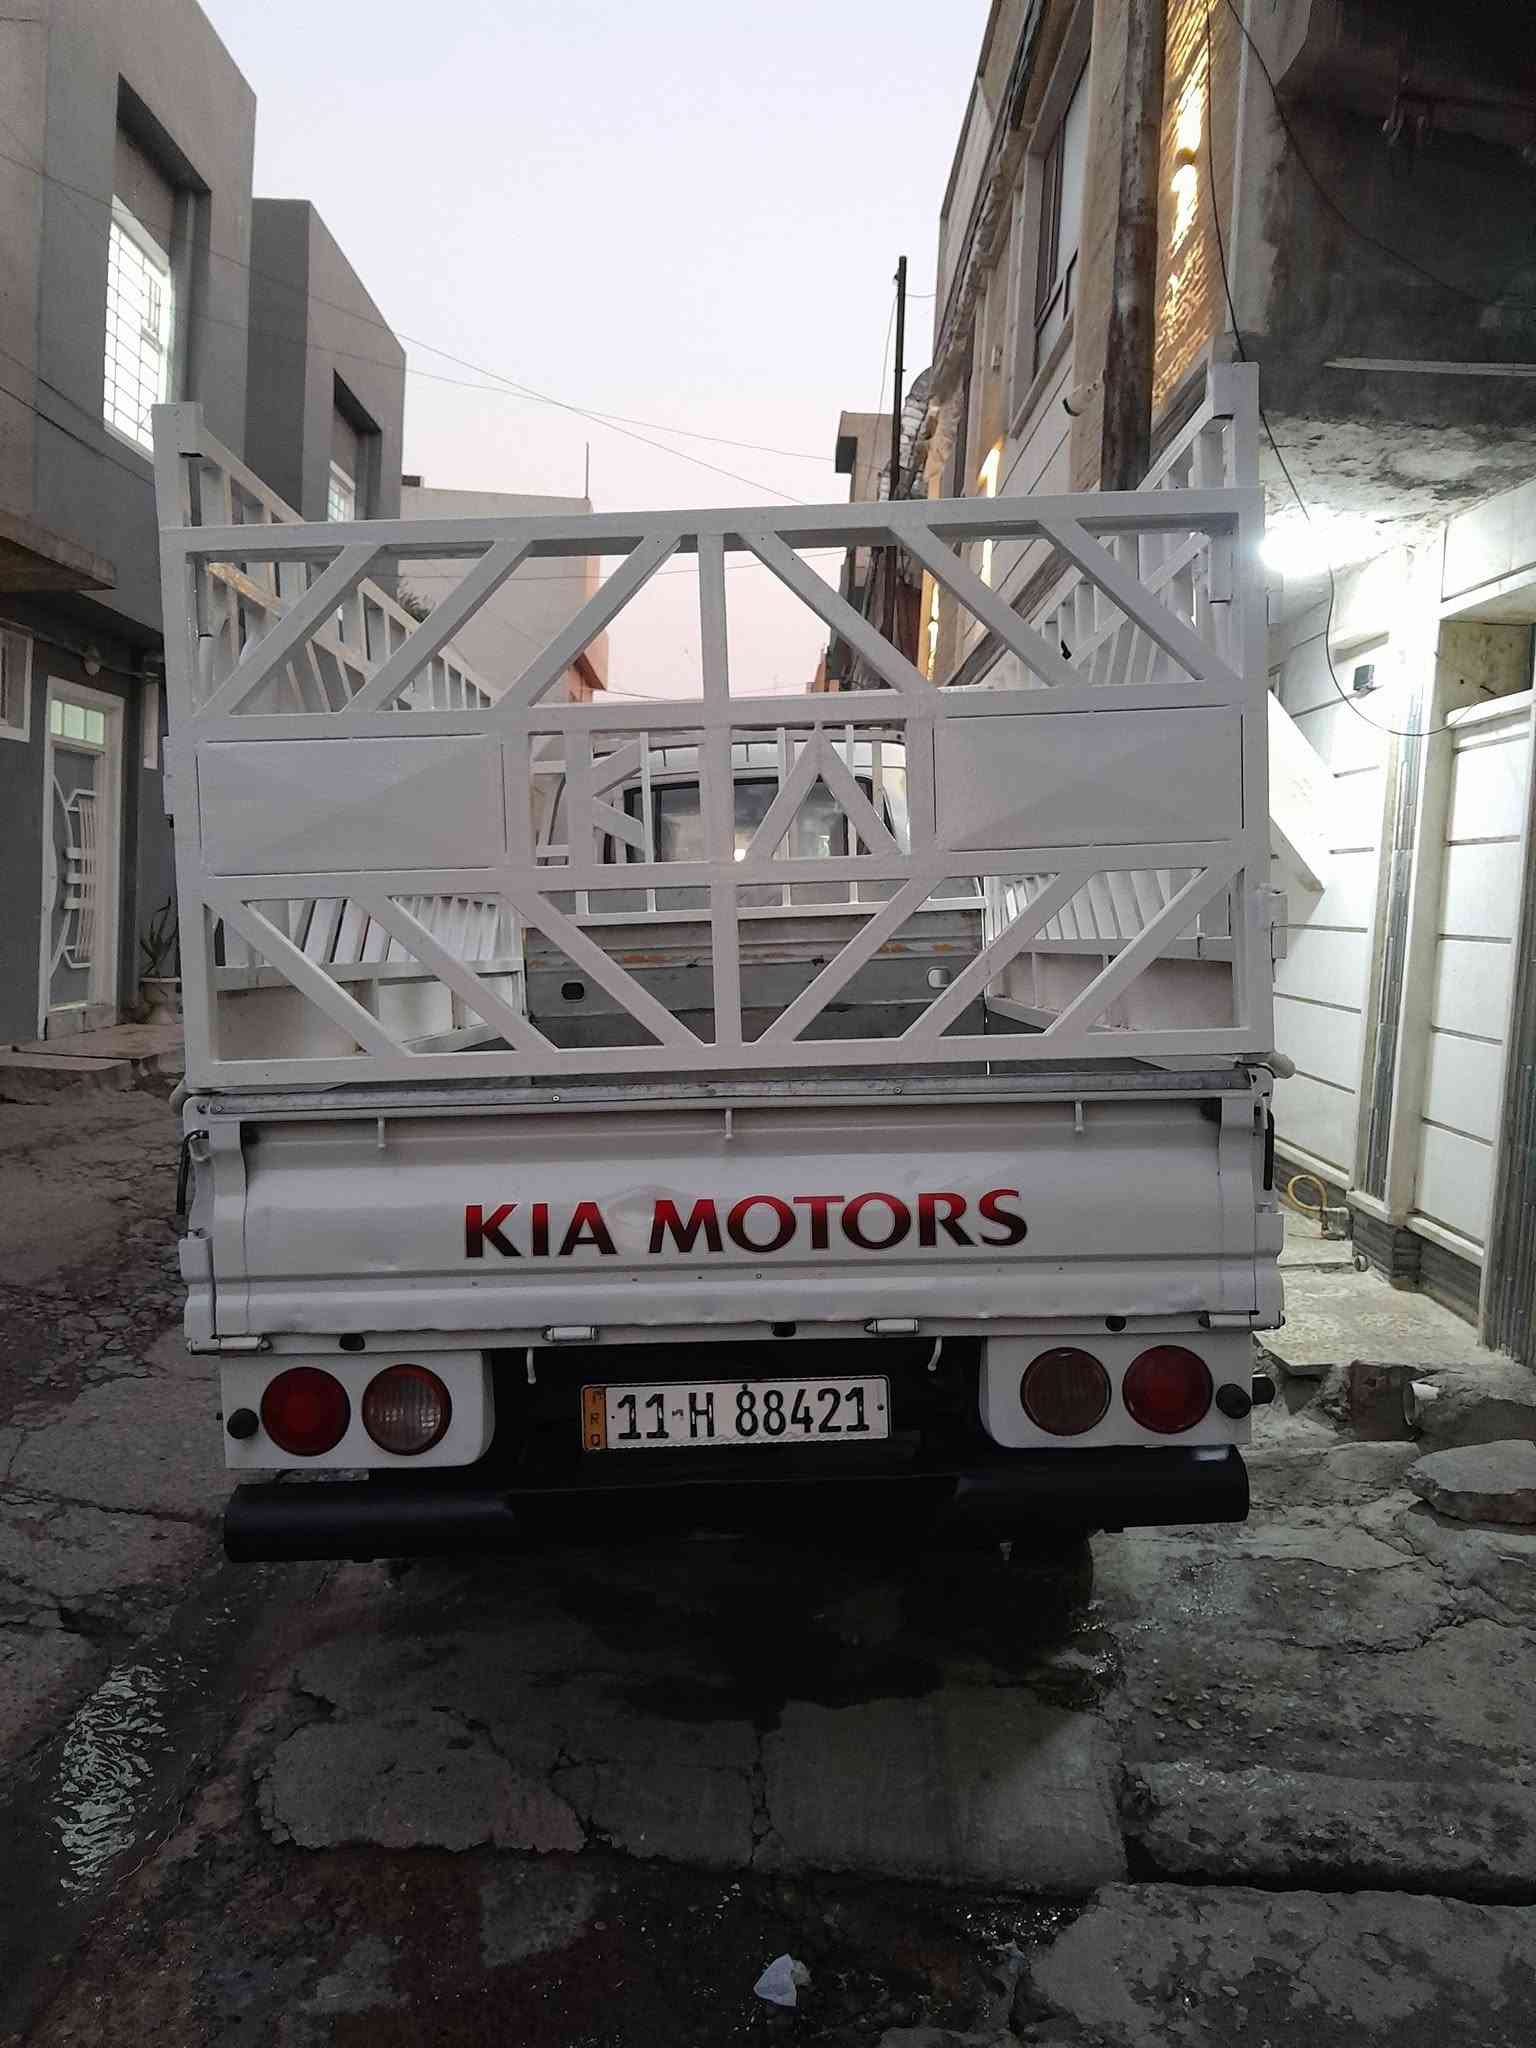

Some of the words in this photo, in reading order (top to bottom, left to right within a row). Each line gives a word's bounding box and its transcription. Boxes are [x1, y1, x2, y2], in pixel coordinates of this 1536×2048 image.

[464, 1200, 620, 1259] KIA
[647, 1188, 1029, 1255] MOTORS
[735, 1387, 870, 1437] 88421
